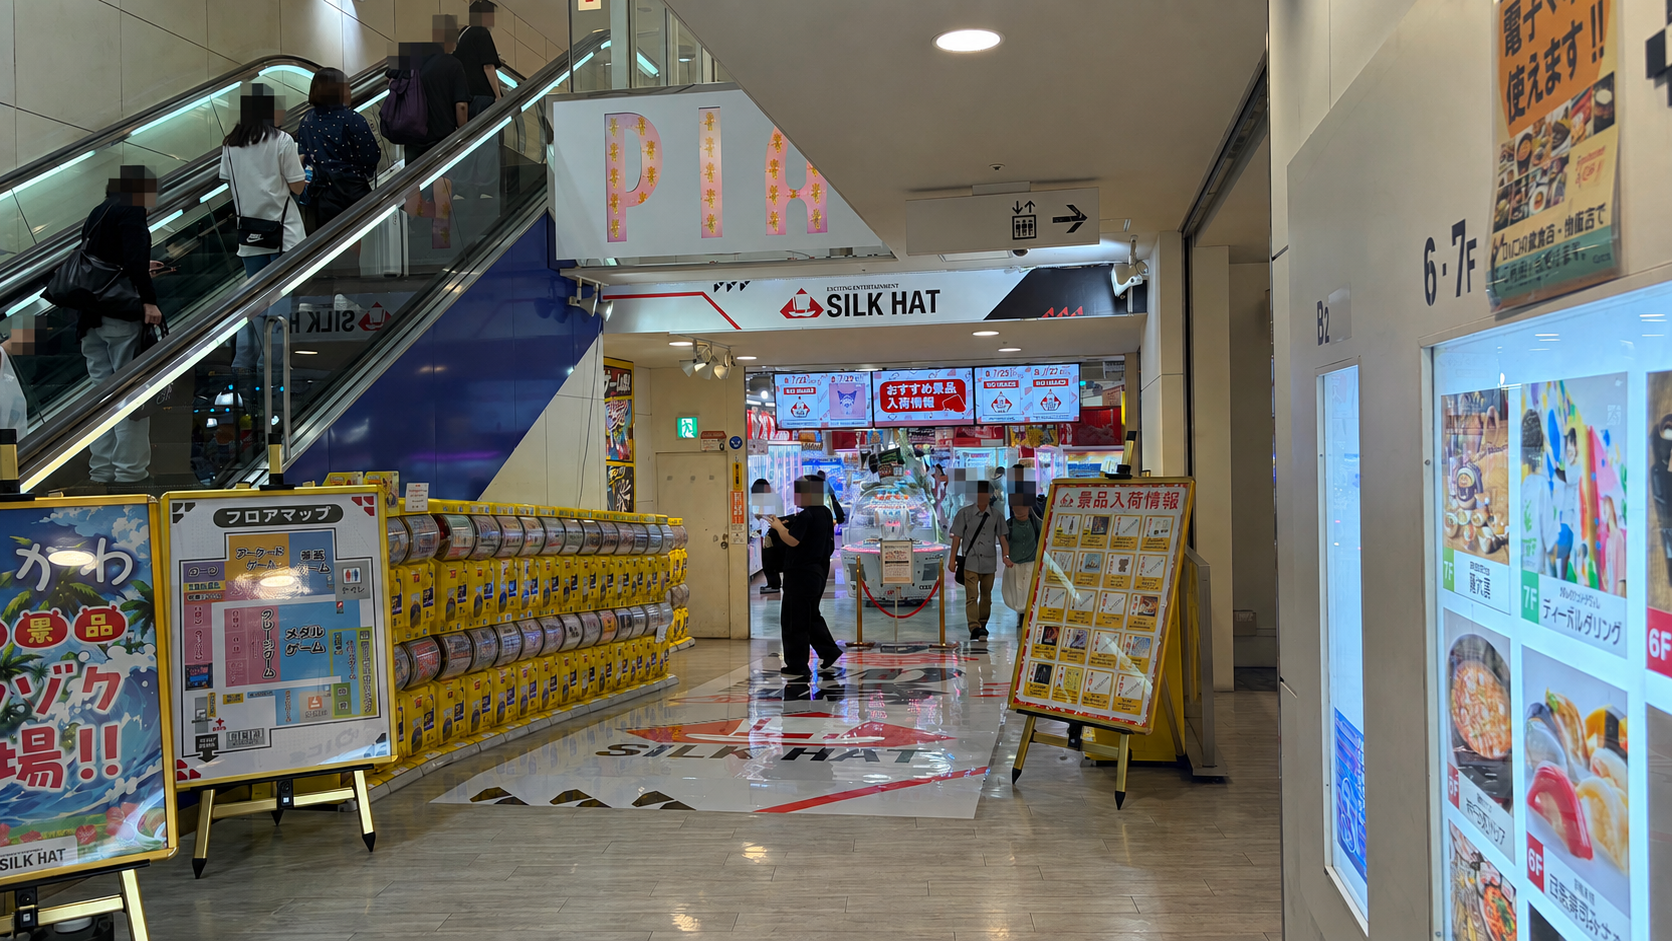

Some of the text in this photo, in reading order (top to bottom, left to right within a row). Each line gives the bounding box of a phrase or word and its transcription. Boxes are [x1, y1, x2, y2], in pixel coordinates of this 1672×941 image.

[1507, 0, 1604, 126] 使えます!!
[853, 283, 899, 291] ENTERTAINMENT
[826, 289, 941, 318] SILK HAT
[1317, 300, 1330, 346] B2
[886, 381, 957, 396] おすすめ景品
[1077, 490, 1180, 510] 景品入荷情報
[226, 505, 332, 525] フロアマップ
[1443, 561, 1454, 582] 7F
[1523, 585, 1538, 611] 7F
[26, 612, 114, 644] 景品
[285, 625, 326, 640] メダル
[285, 641, 327, 657] ゲーム
[1649, 627, 1672, 661] 6F
[0, 663, 122, 715] ゾク
[595, 743, 934, 763] SILK HAT
[0, 853, 33, 871] SILK
[37, 848, 66, 865] HAT
[1528, 848, 1544, 877] 6F
